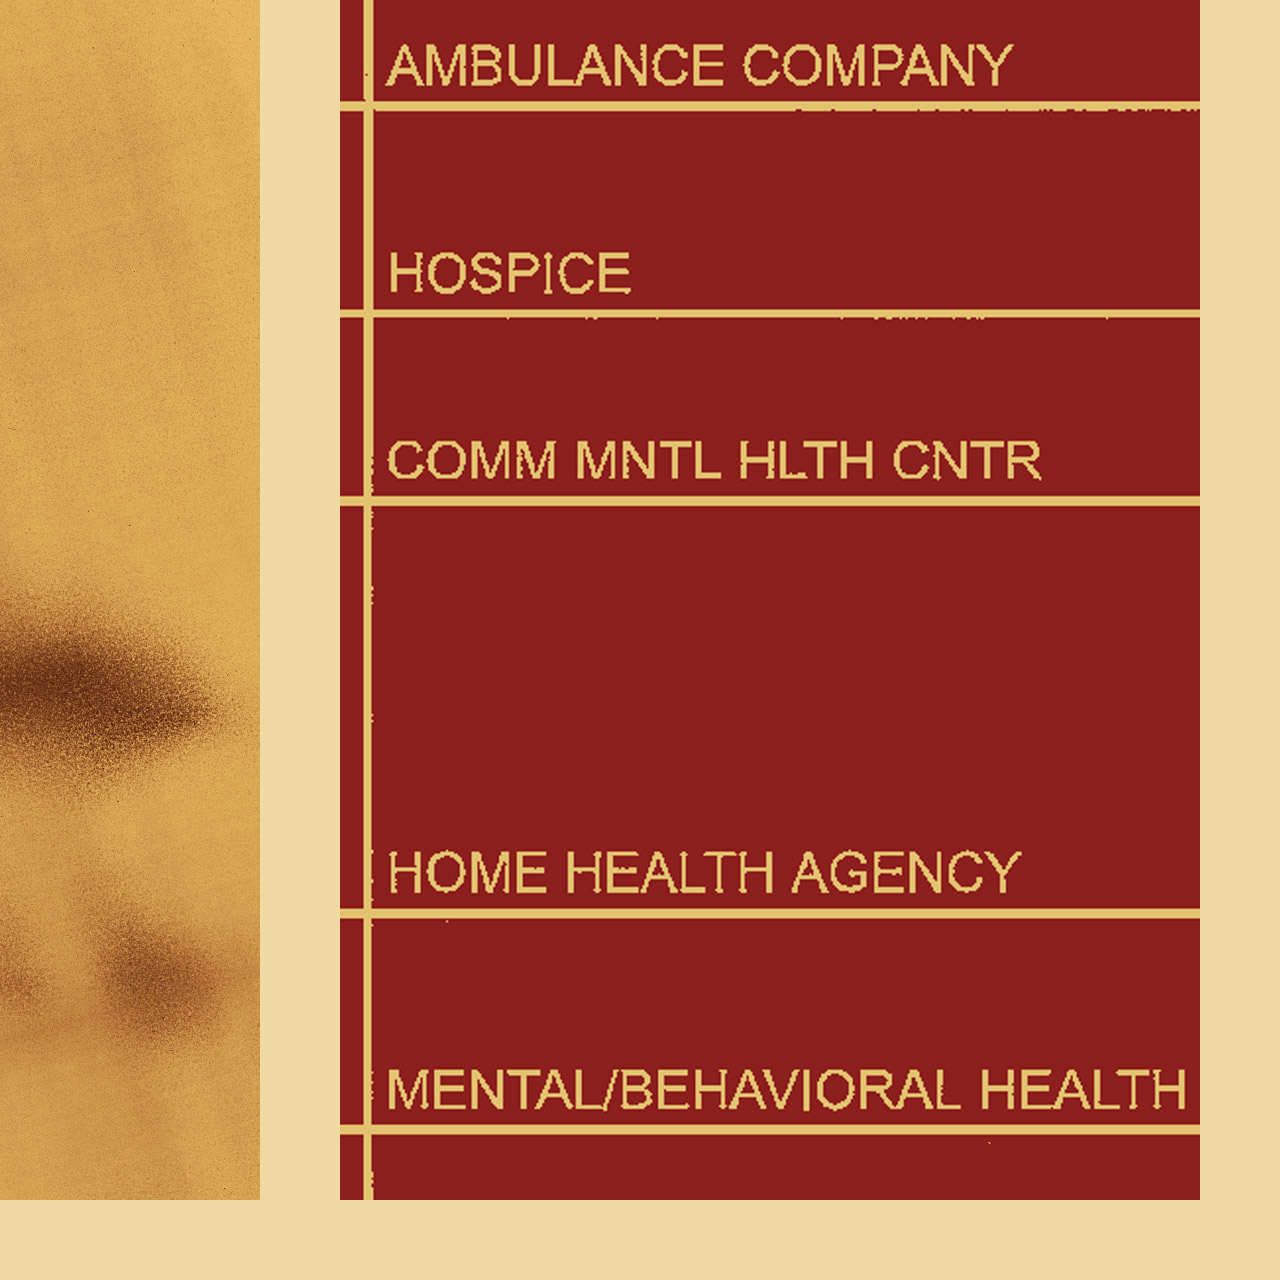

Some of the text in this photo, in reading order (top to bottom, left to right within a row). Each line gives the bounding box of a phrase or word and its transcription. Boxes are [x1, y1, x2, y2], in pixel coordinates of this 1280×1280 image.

[386, 43, 1015, 87] AMBULANCE COMPANY
[390, 251, 632, 295] HOSPICE
[386, 440, 1042, 481] COMM MNTL HLTH CNTR
[388, 849, 1023, 894] HOME HEALTH AGENCY
[388, 1068, 1186, 1112] MENTAL/BEHAVIORAL HEALTH
